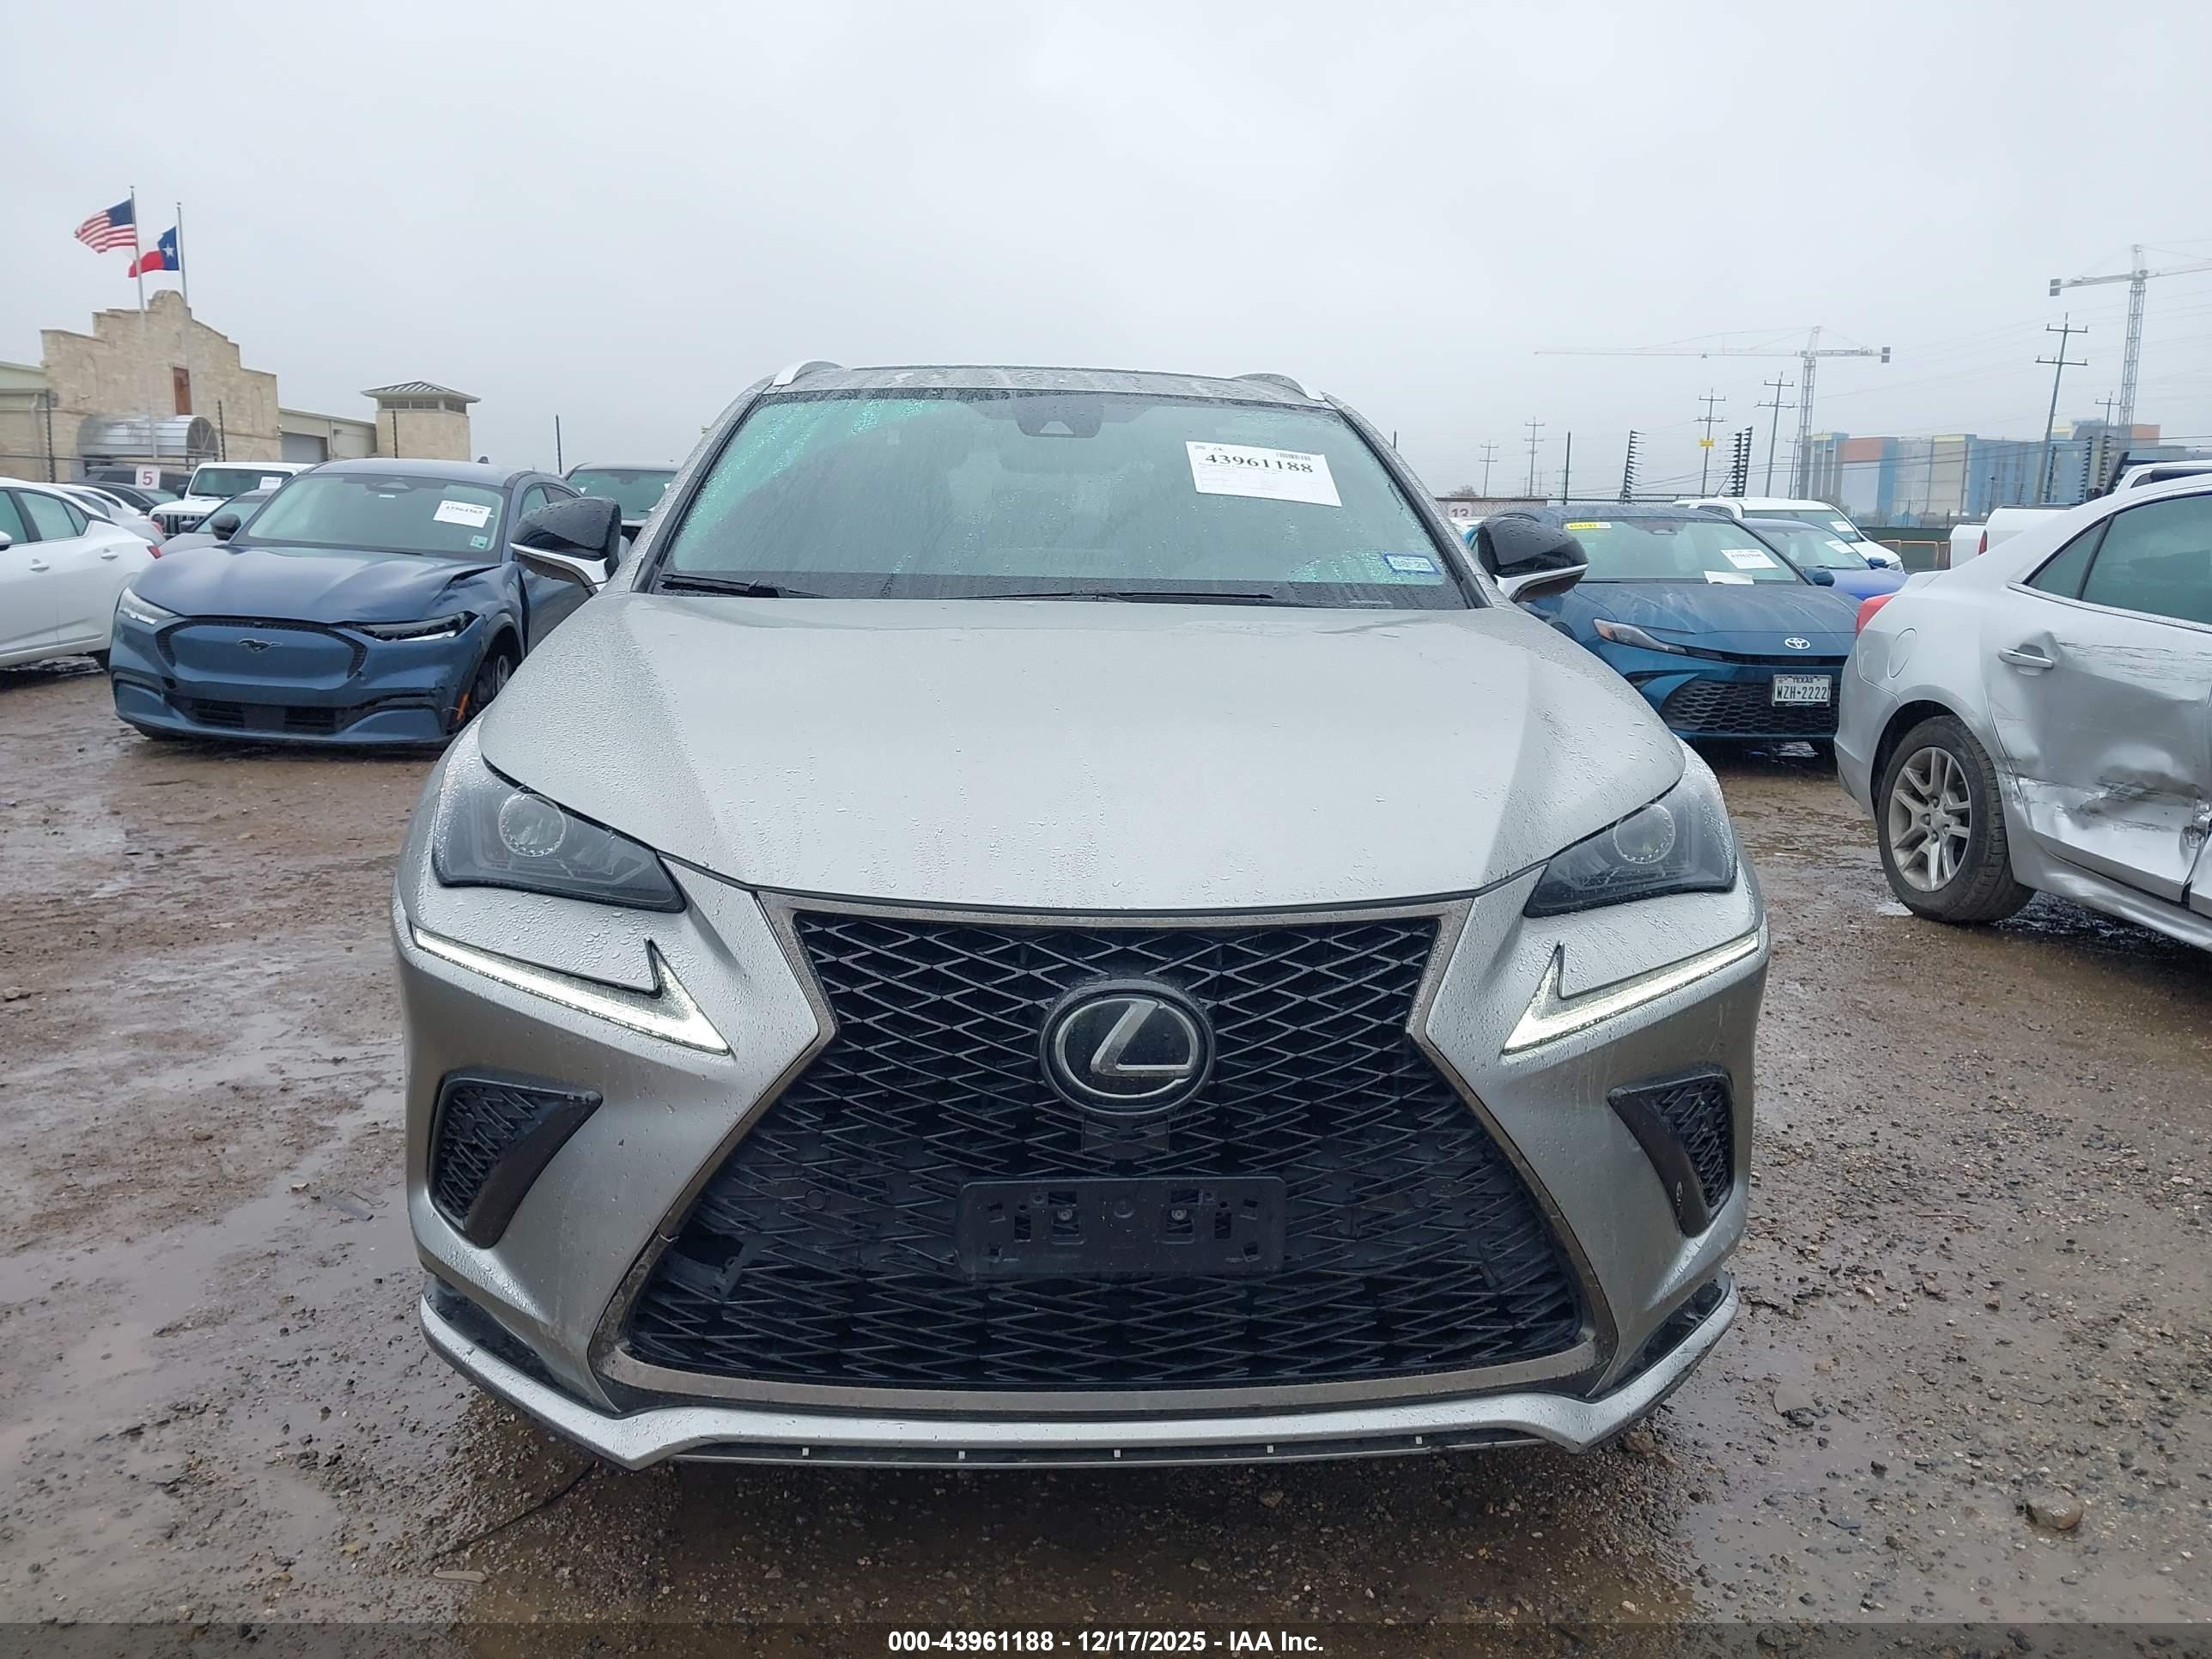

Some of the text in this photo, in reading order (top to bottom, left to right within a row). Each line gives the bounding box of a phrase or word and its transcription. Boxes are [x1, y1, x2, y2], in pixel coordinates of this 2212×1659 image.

[1205, 453, 1314, 473] 43961188
[142, 471, 154, 486] 5
[1792, 675, 1814, 684] TEXAS
